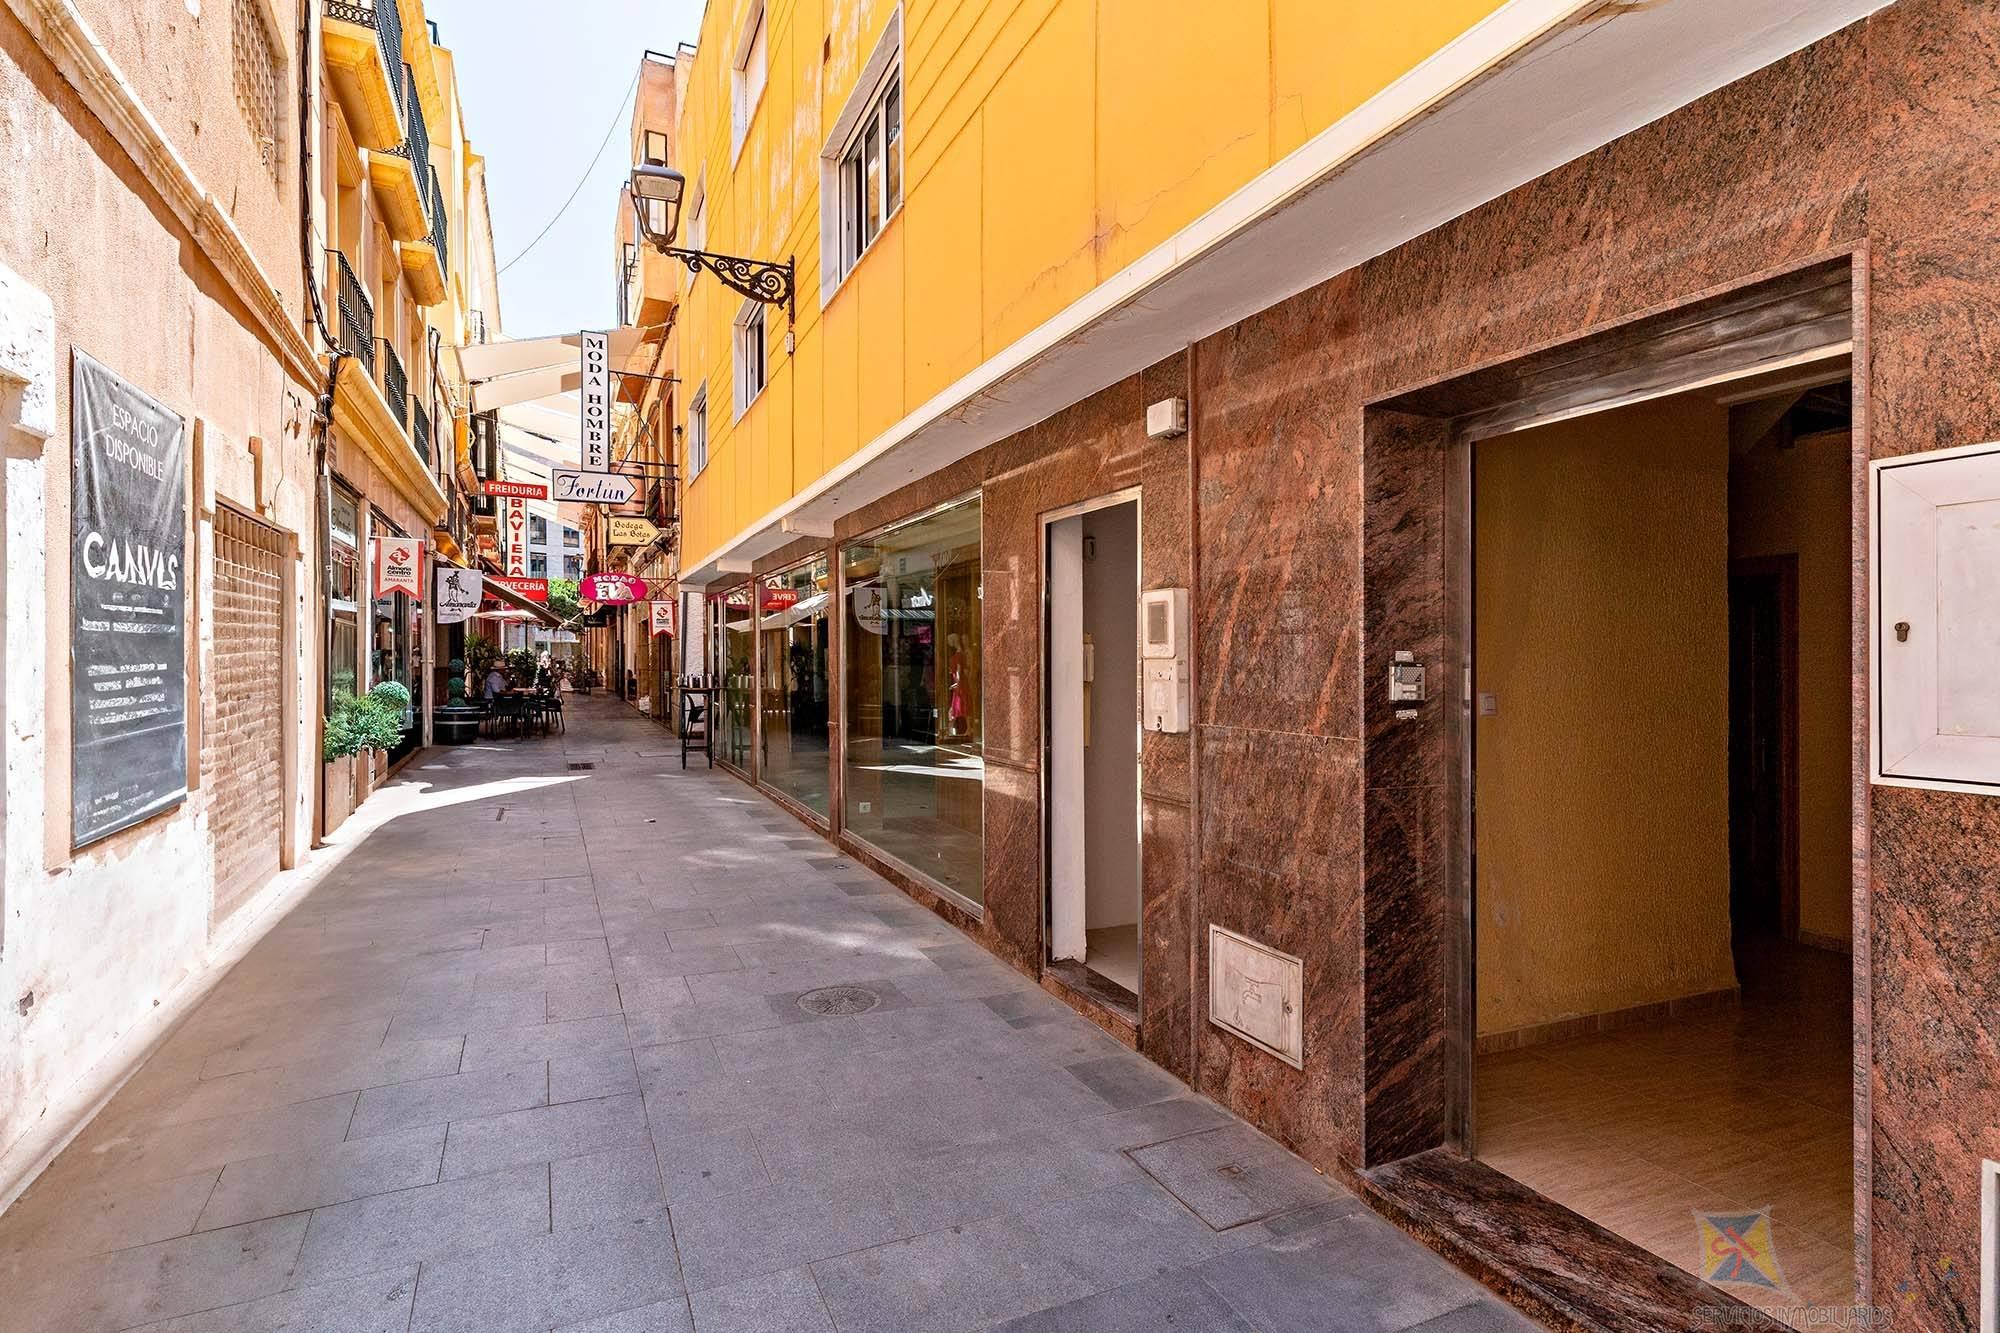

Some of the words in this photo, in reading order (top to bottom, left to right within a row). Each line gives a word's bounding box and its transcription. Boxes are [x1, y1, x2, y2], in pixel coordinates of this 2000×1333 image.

[586, 338, 603, 386] MODA
[112, 403, 158, 448] ESPACIO
[586, 394, 603, 467] HOMBRE
[105, 433, 164, 482] DISPONIBLE
[488, 483, 543, 497] FREIDURIA
[509, 498, 524, 577] BAVIERA
[613, 529, 628, 537] Las
[614, 520, 643, 531] Bodega
[592, 574, 636, 584] MODAS
[594, 581, 636, 601] EVA
